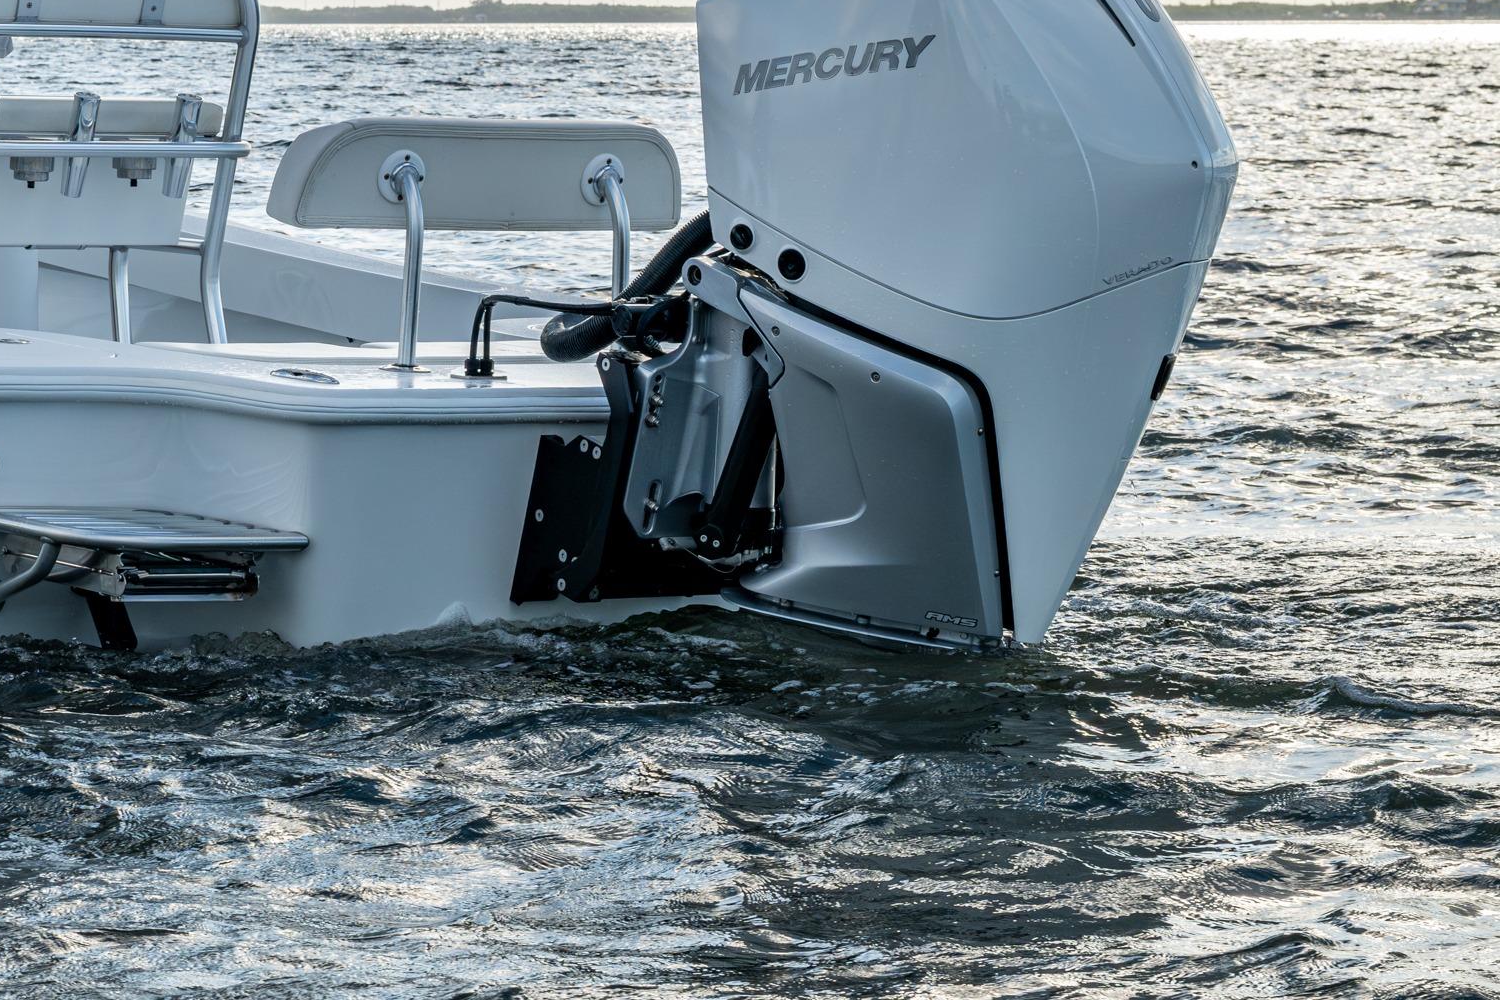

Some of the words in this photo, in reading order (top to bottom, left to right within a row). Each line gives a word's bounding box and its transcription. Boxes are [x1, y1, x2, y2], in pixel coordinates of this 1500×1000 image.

[733, 34, 936, 96] MERCURY
[1102, 256, 1173, 285] VERADO
[925, 611, 978, 628] AMS
